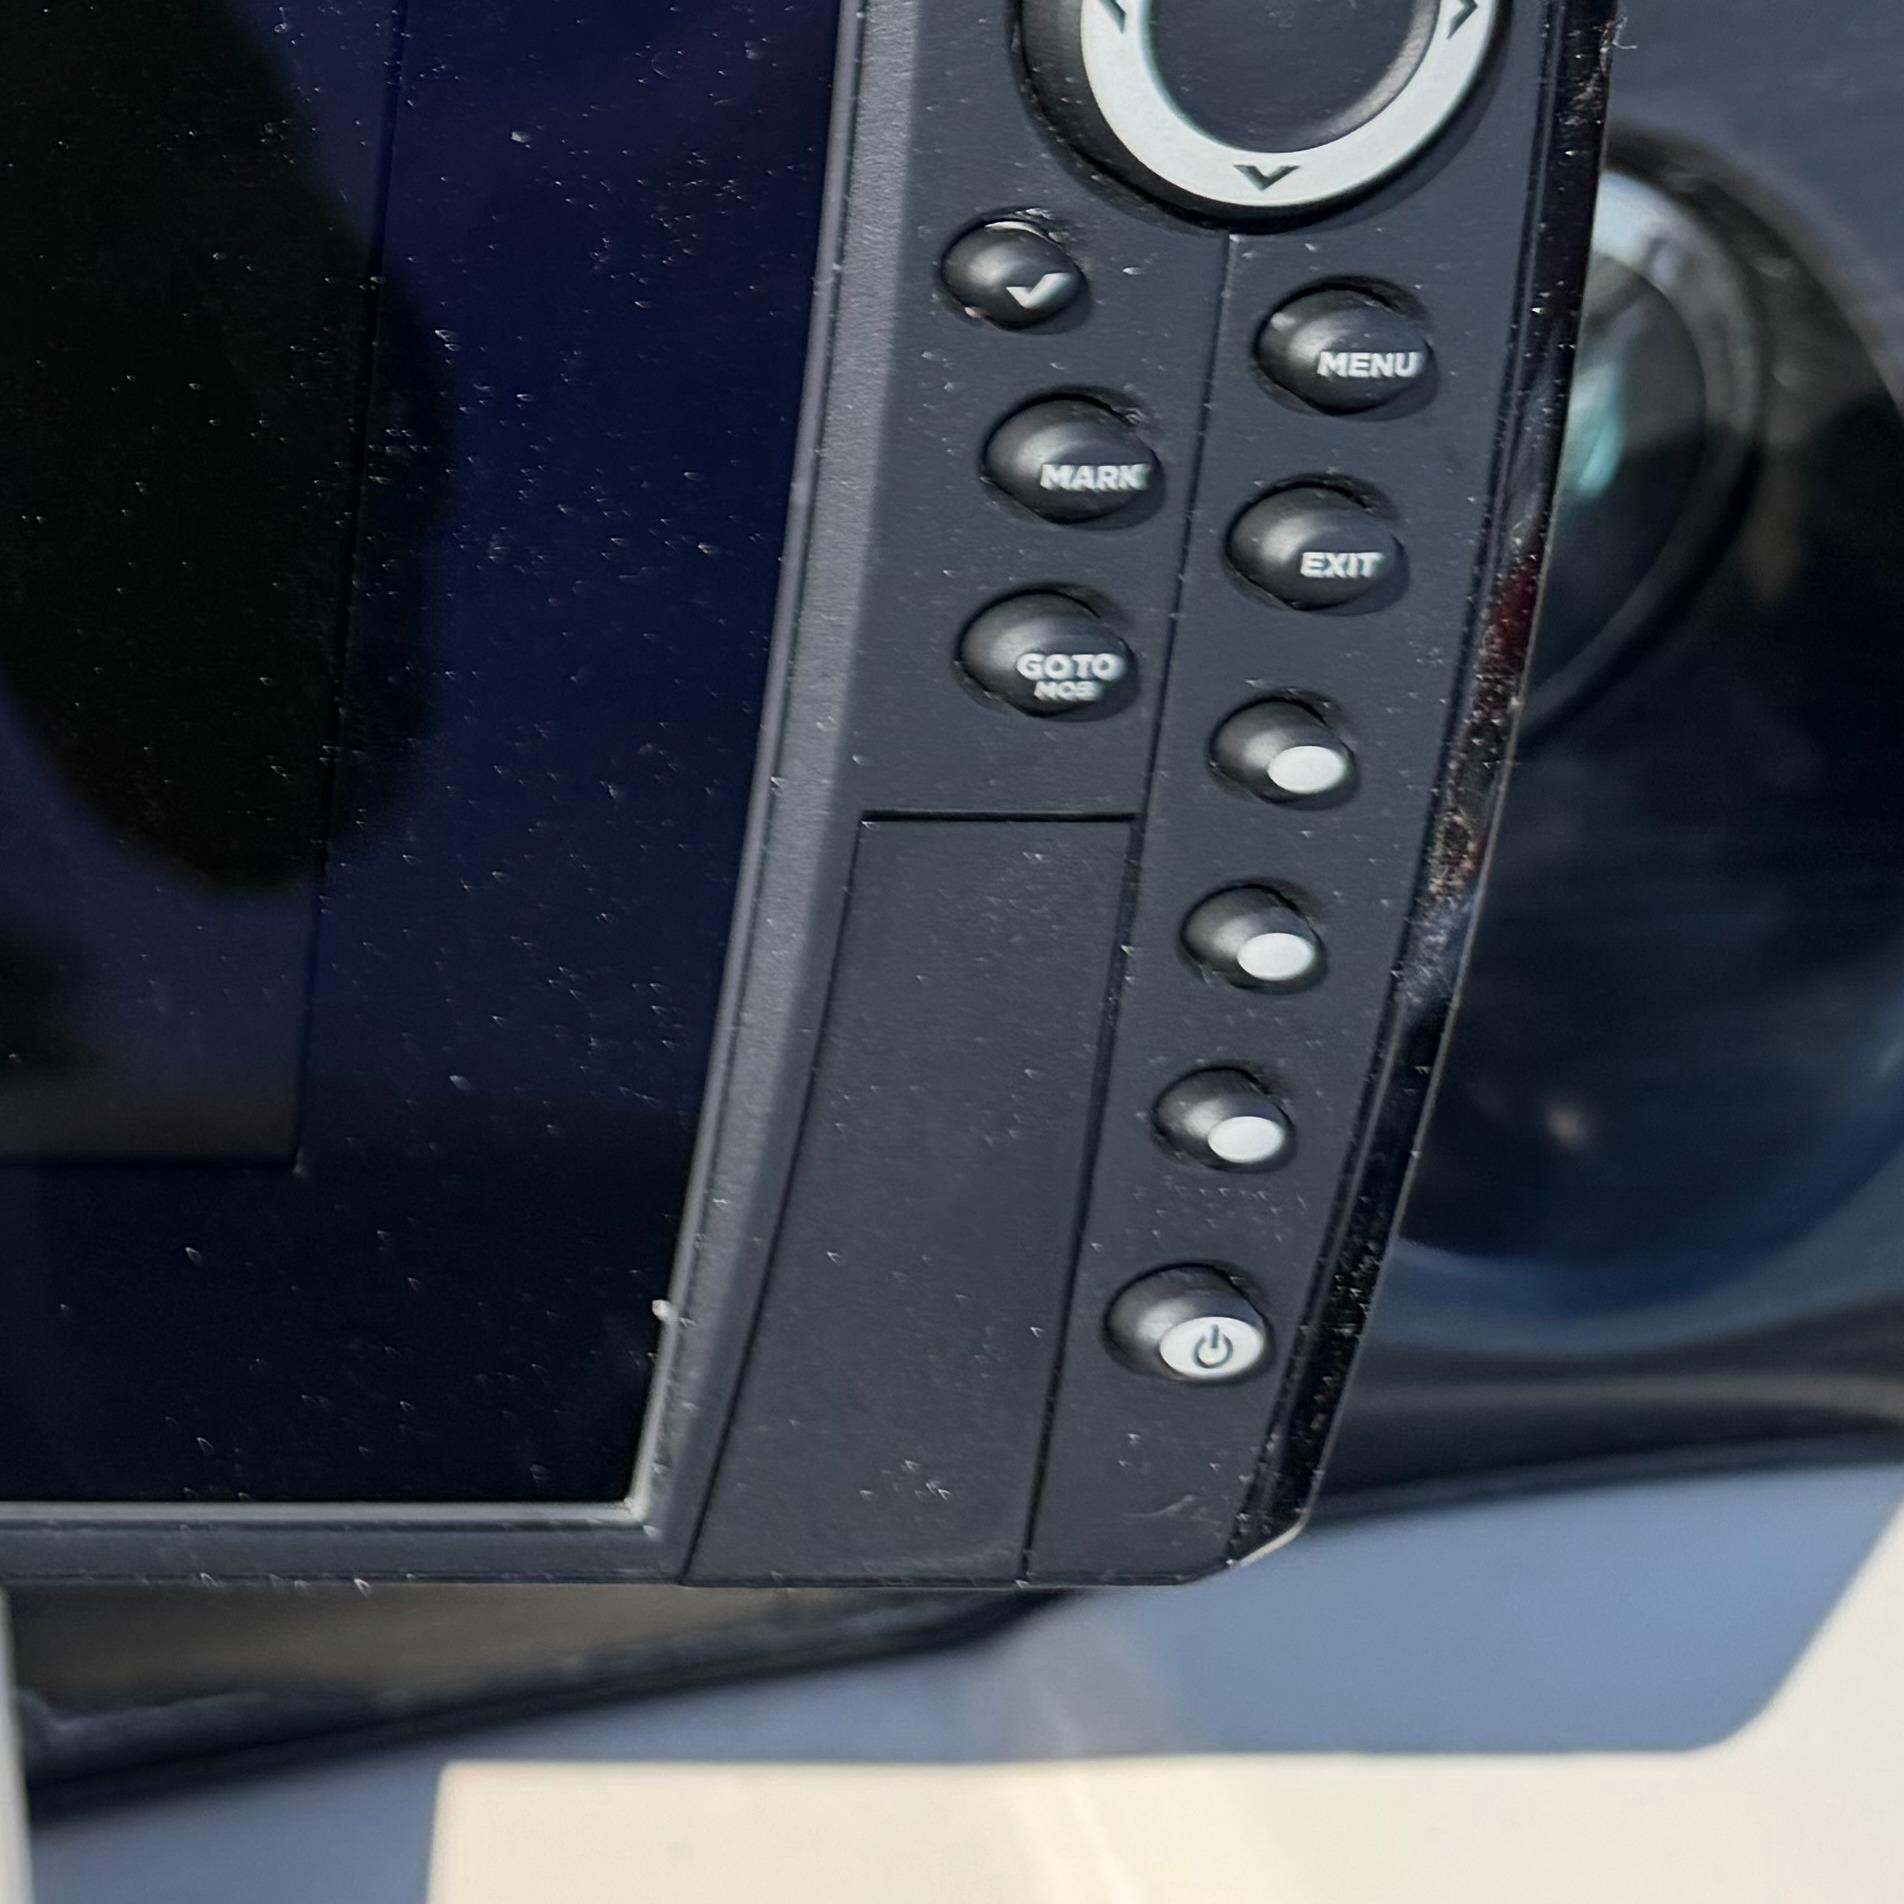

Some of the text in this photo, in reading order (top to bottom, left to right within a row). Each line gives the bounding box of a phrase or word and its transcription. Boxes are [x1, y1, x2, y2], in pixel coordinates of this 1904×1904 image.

[1317, 351, 1422, 379] MENU
[1040, 462, 1149, 491] MARK
[1300, 551, 1384, 579] EXIT
[1017, 653, 1126, 681] GOTO
